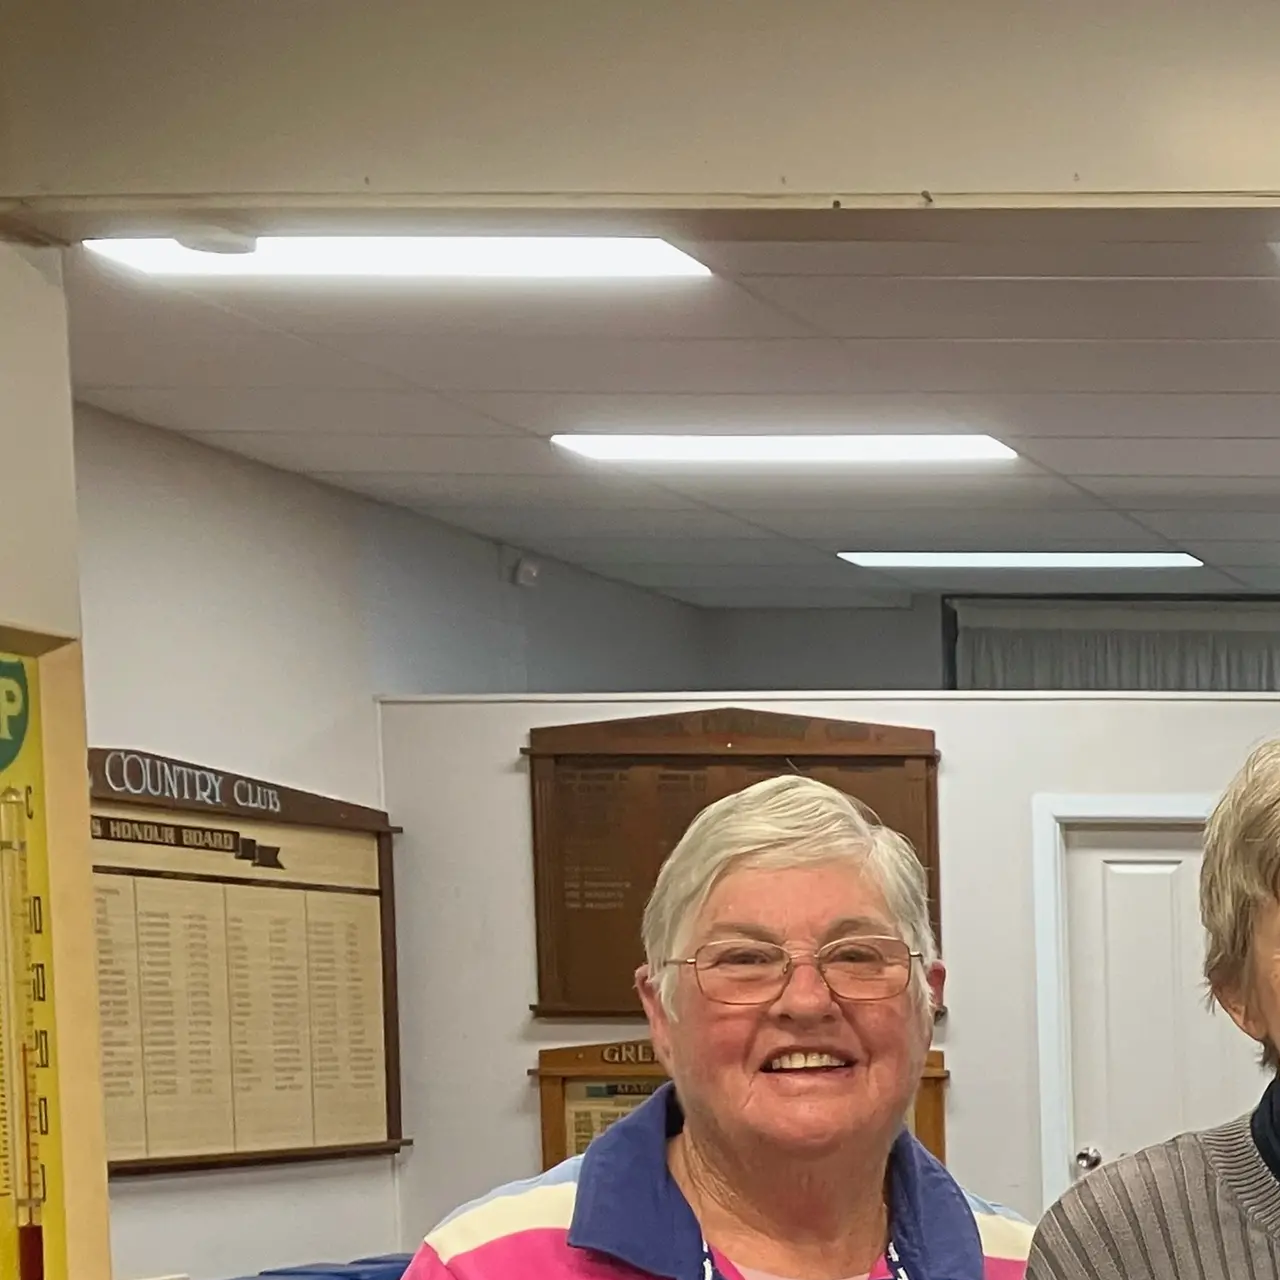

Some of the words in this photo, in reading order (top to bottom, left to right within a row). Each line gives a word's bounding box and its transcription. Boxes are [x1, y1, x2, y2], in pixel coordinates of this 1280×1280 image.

[105, 751, 225, 805] COUNTRY
[233, 780, 281, 813] CLUB
[109, 820, 176, 846] HONOUR
[181, 827, 235, 852] BOARD
